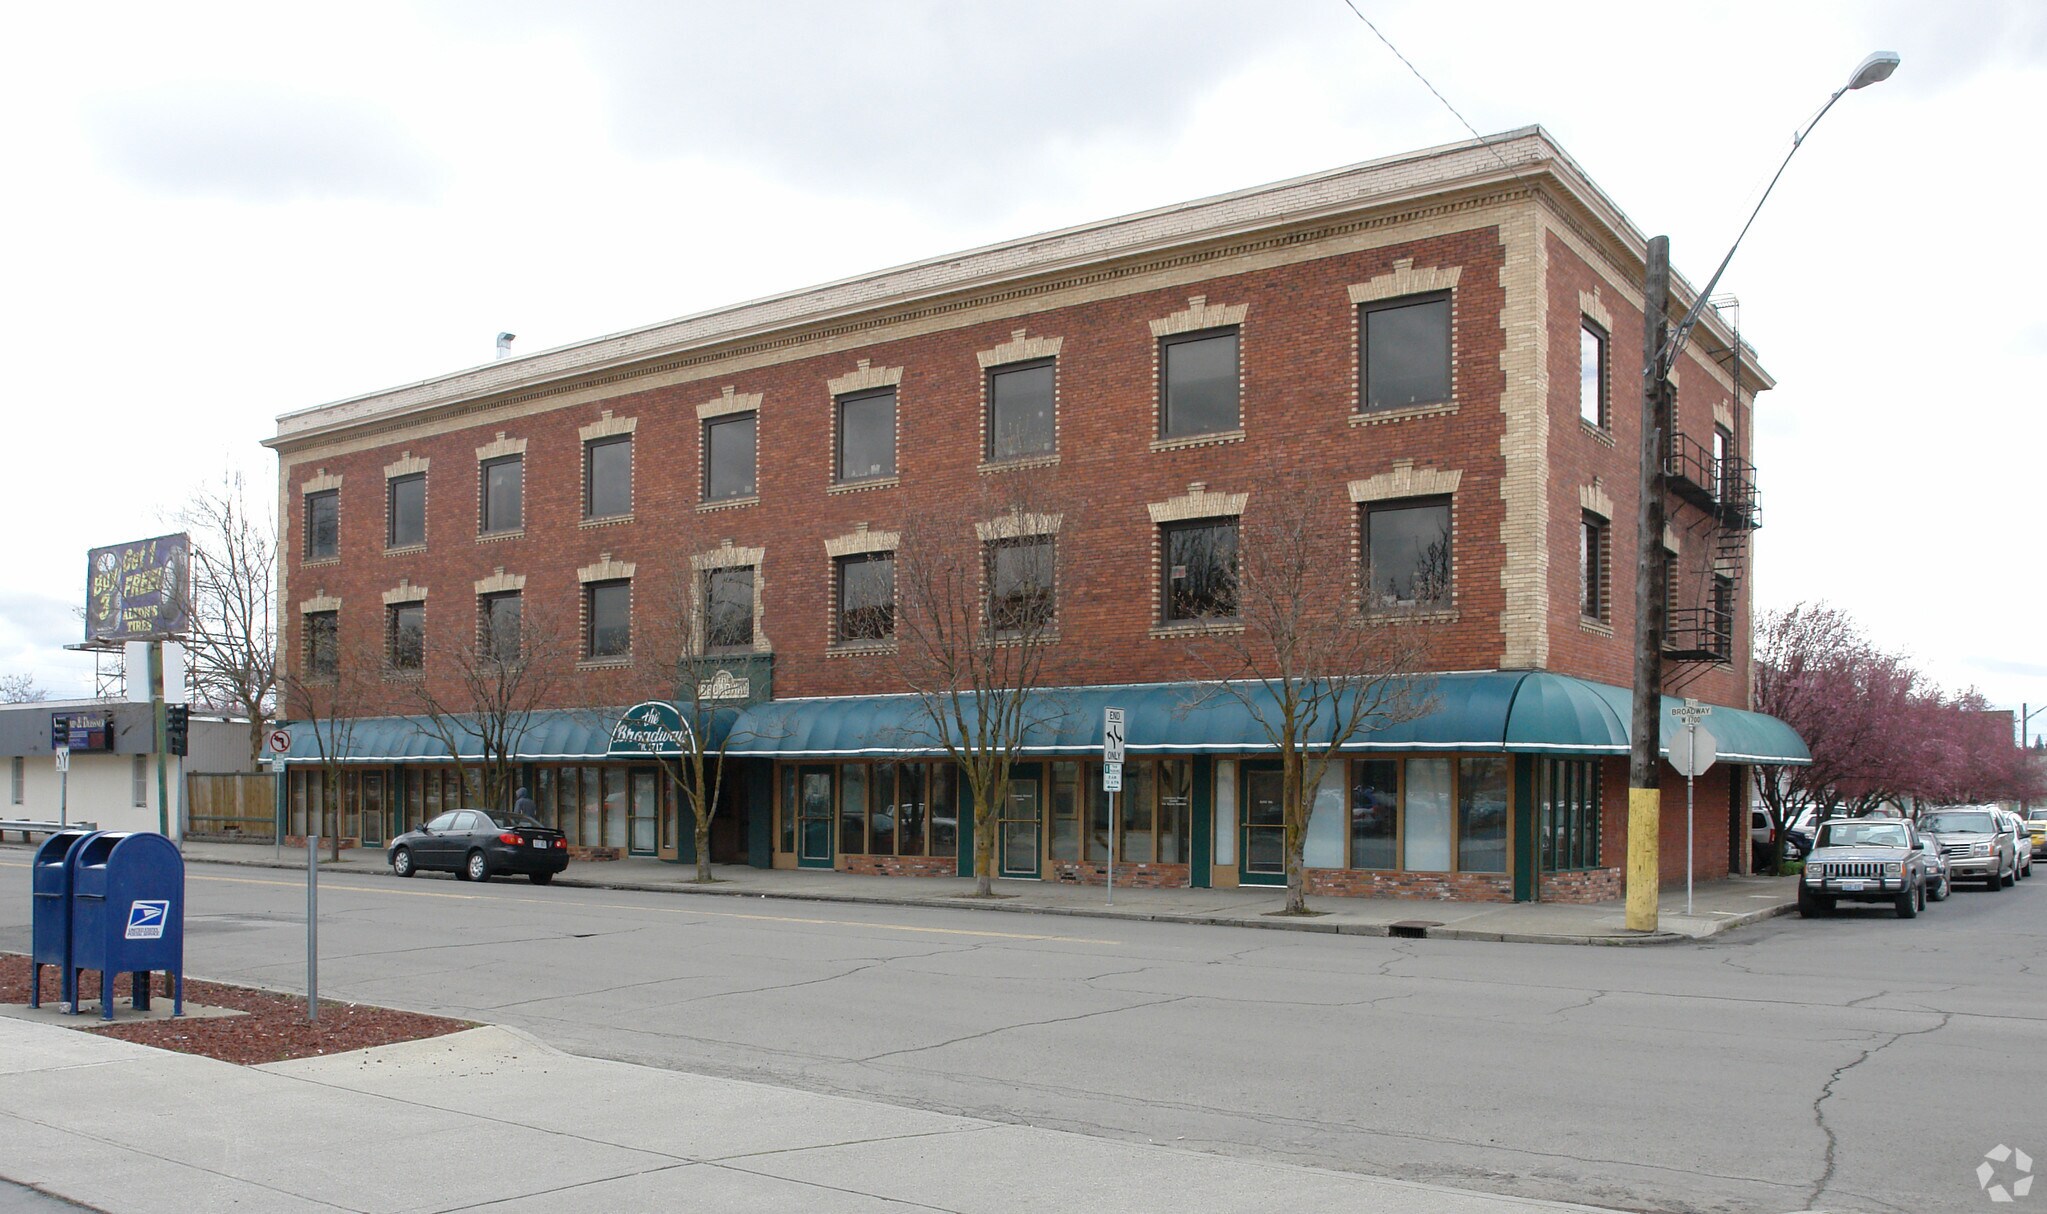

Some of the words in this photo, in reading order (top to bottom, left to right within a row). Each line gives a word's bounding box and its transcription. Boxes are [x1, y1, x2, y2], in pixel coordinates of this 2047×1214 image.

[123, 545, 146, 572] Get
[99, 594, 111, 621] 3
[127, 619, 152, 633] TIRES
[641, 707, 661, 727] the
[1109, 711, 1121, 720] END
[613, 724, 688, 747] Broadway
[1107, 751, 1122, 760] ONLY
